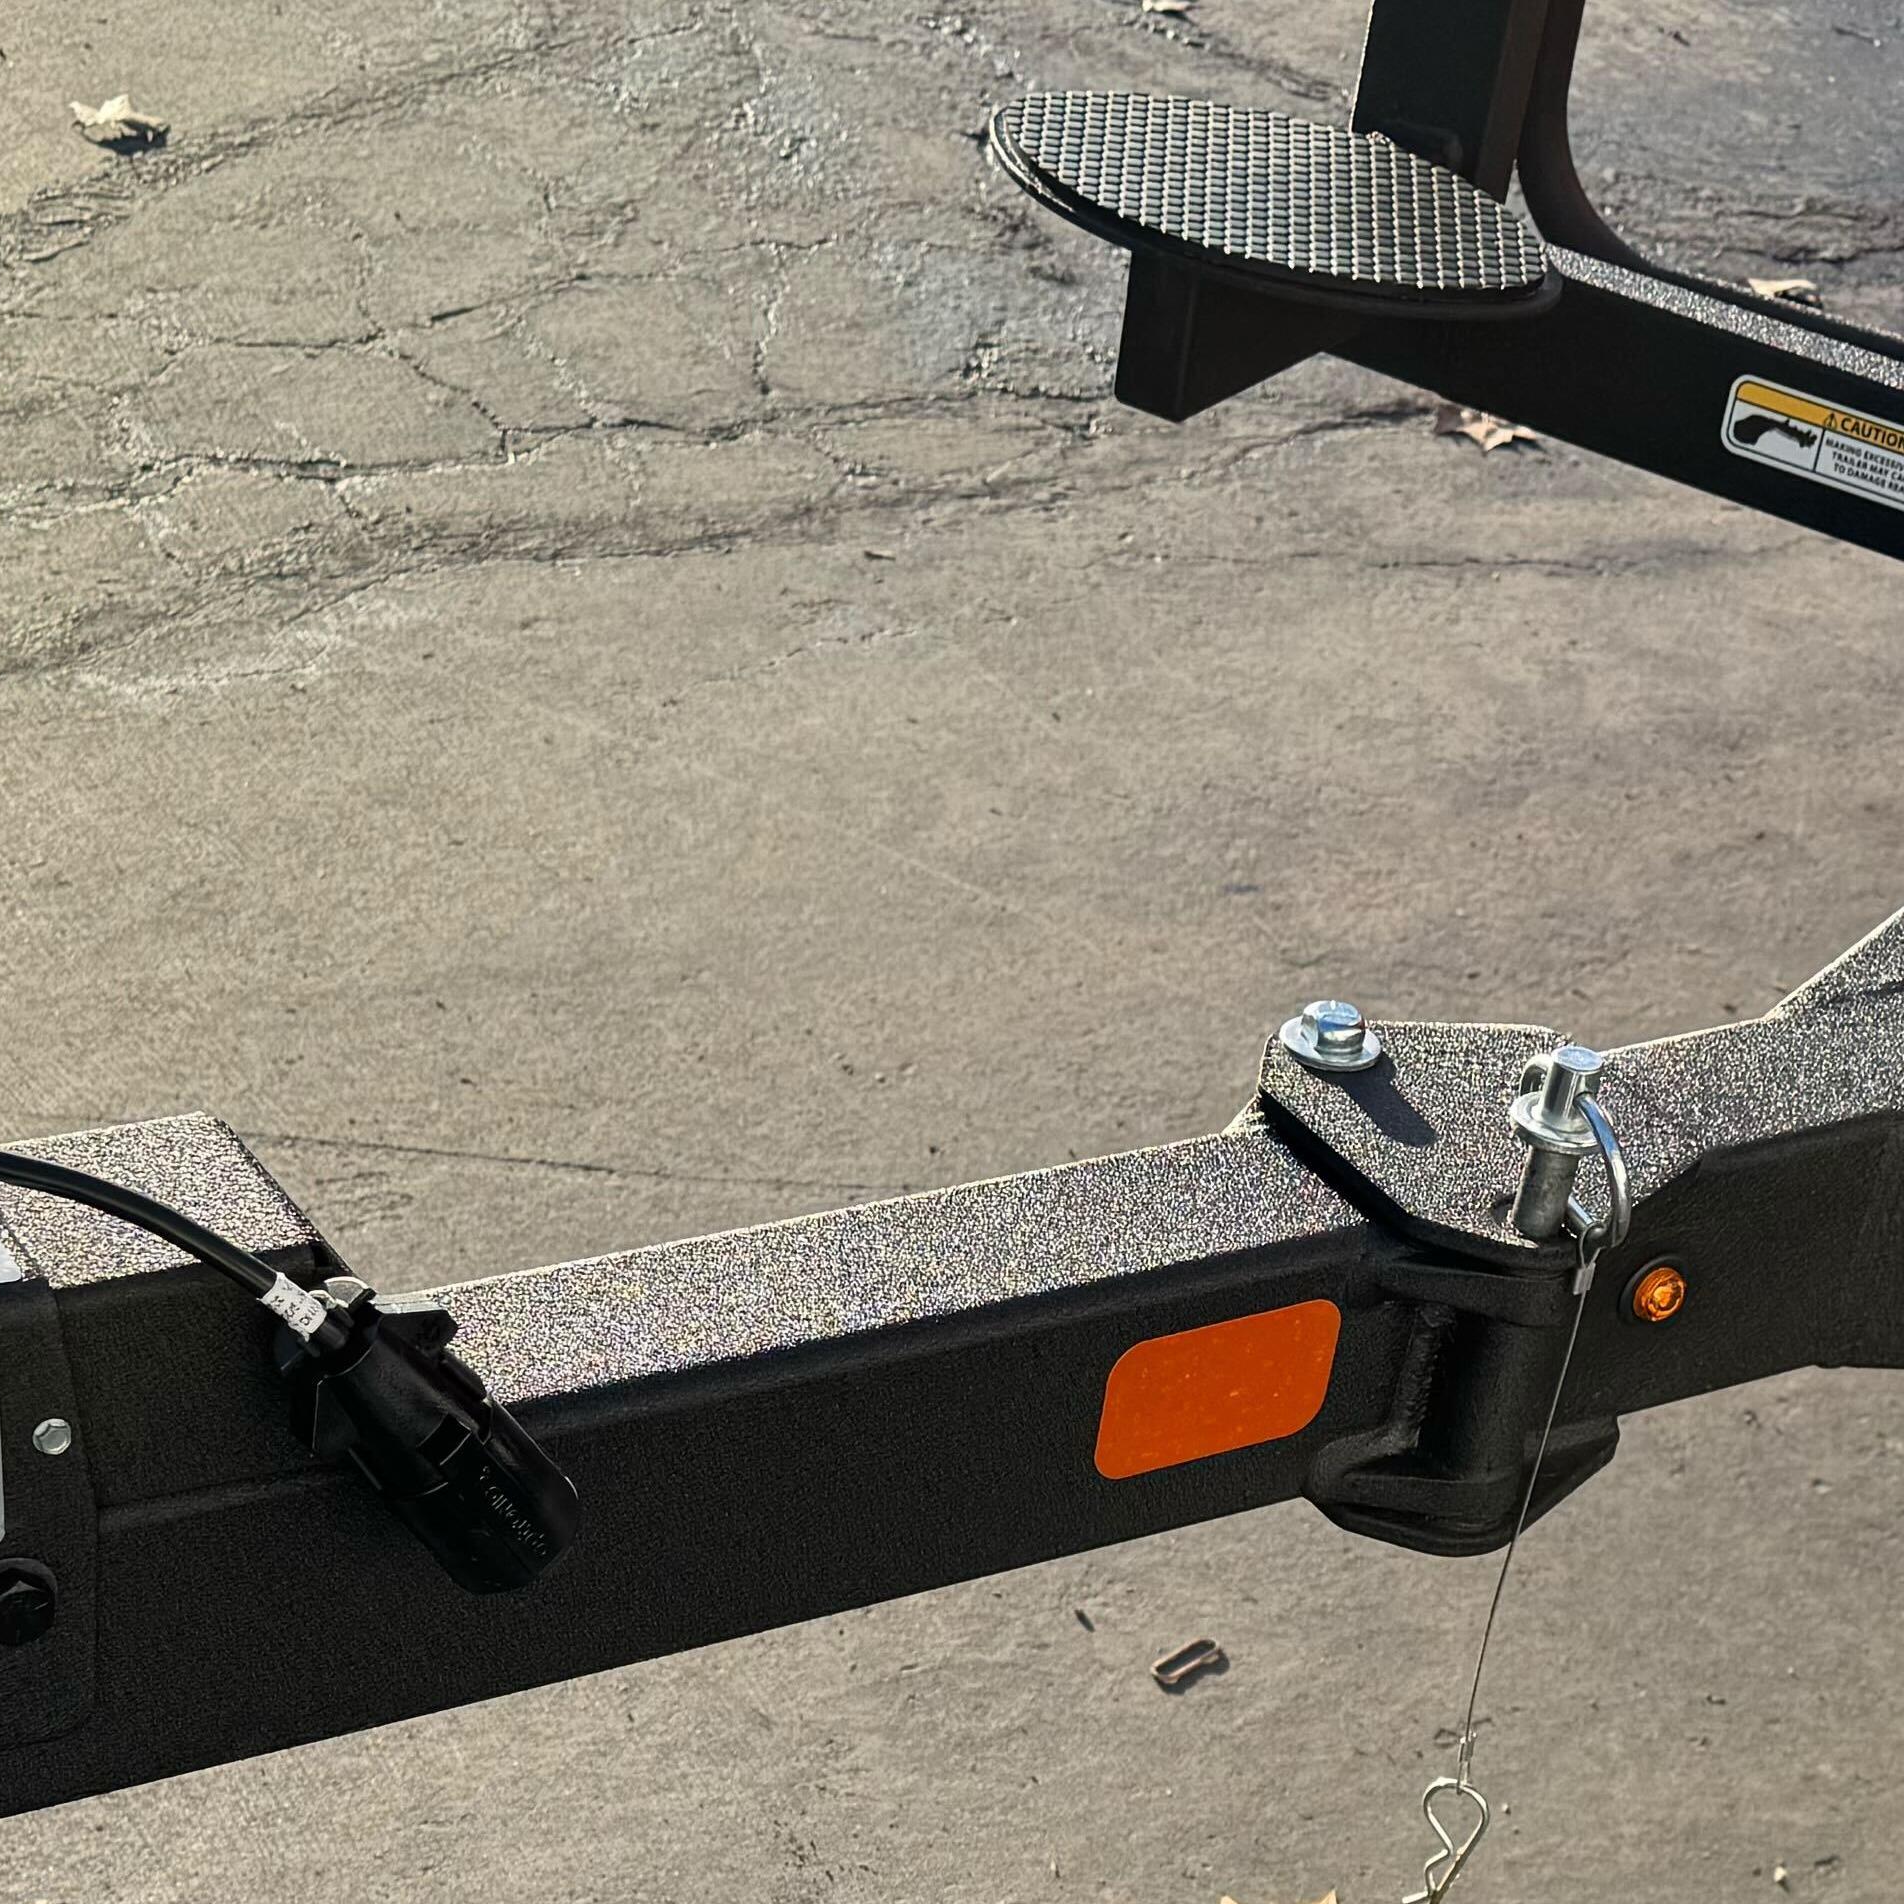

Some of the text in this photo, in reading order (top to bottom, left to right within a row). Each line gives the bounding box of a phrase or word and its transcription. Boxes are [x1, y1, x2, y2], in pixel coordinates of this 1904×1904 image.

[1825, 437, 1862, 456] MAKING
[1831, 450, 1867, 469] TRAILER
[1869, 463, 1888, 476] MAY
[1833, 462, 1845, 474] TO
[1847, 467, 1886, 488] DAMAGE
